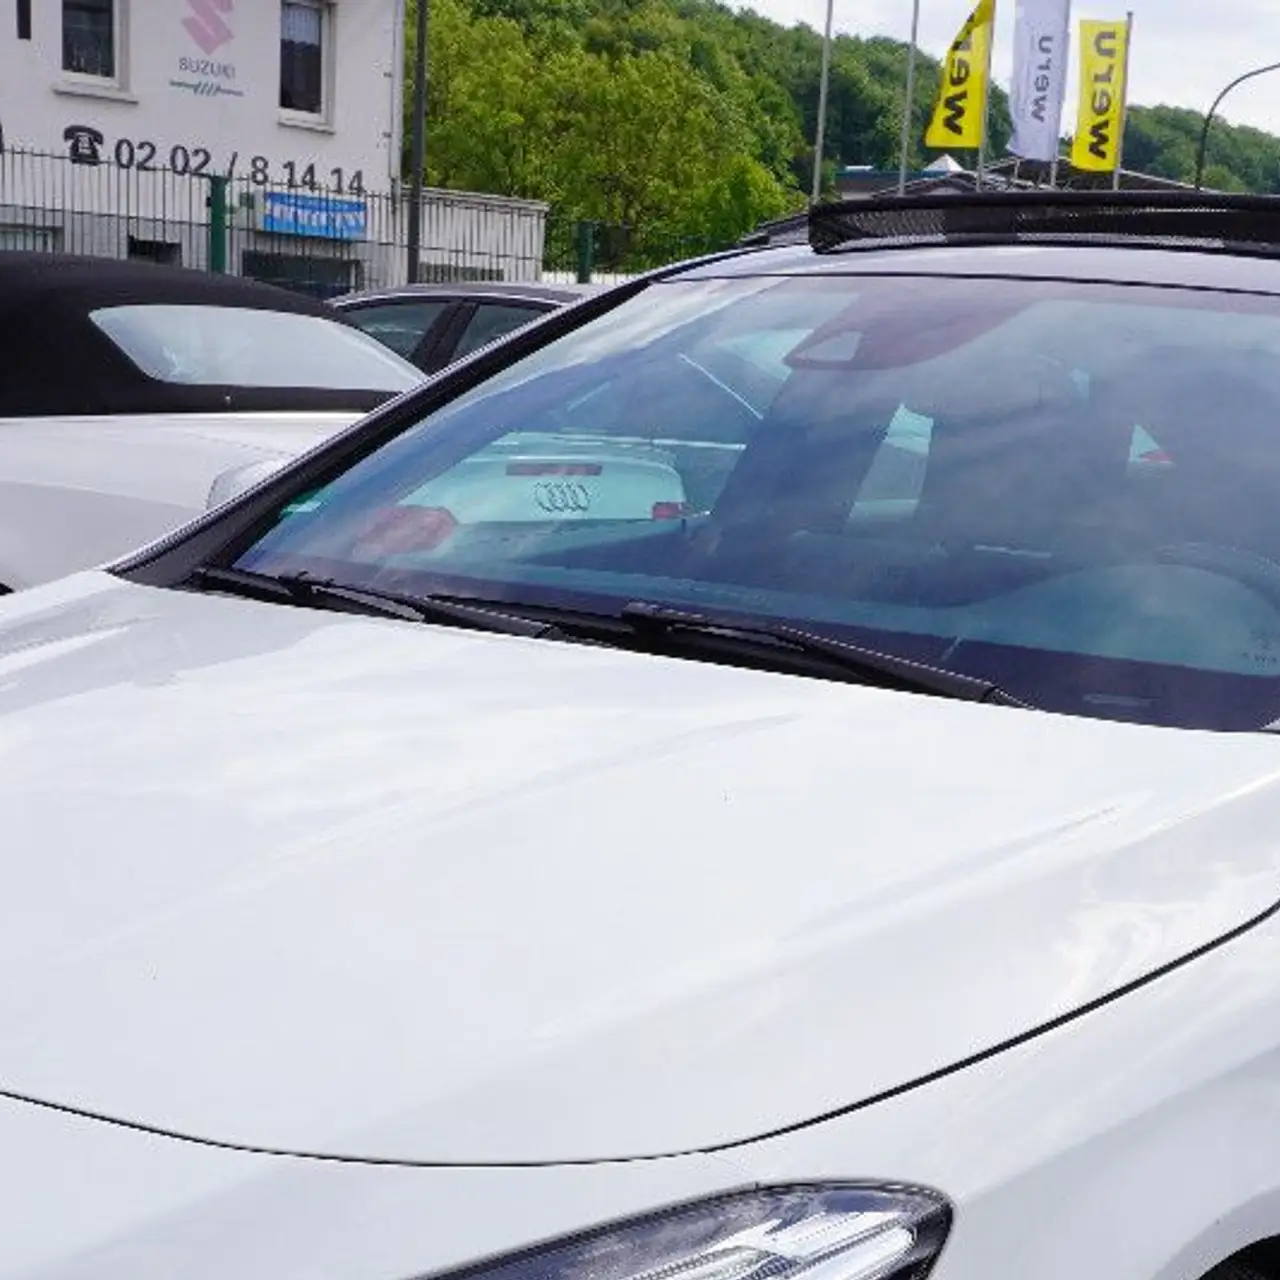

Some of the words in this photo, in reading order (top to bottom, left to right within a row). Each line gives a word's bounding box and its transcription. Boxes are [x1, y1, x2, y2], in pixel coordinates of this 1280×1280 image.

[179, 57, 236, 80] SUZUKI
[114, 138, 157, 172] 02
[170, 144, 211, 177] 02
[251, 156, 269, 186] 8
[282, 160, 318, 192] 14
[330, 167, 367, 198] 14
